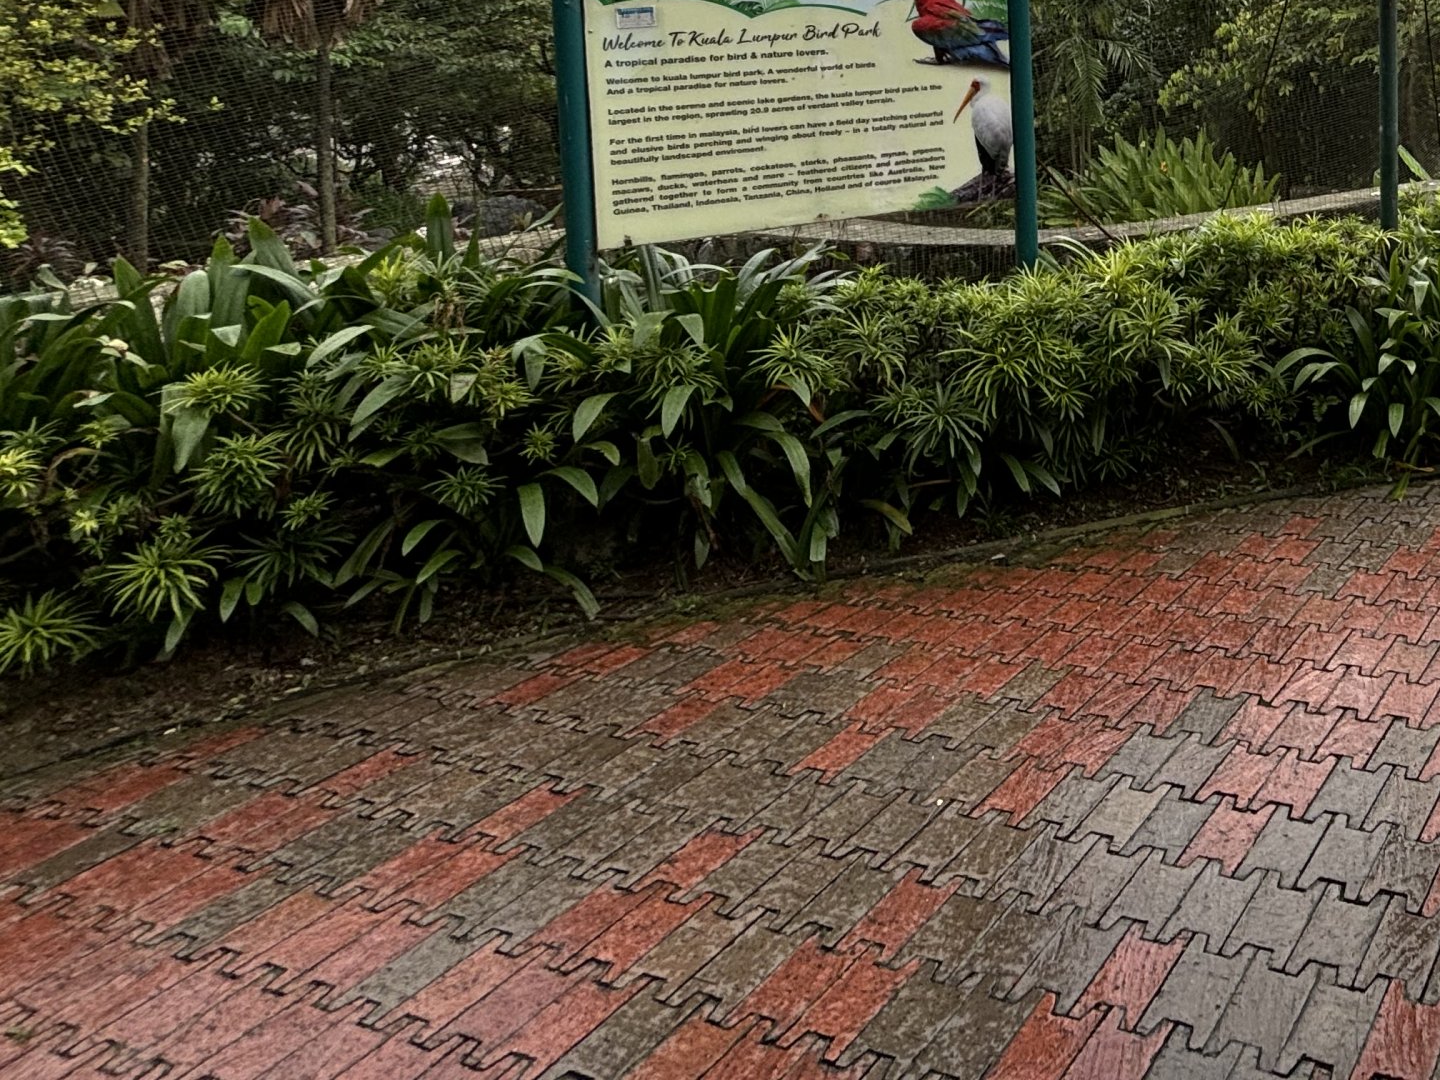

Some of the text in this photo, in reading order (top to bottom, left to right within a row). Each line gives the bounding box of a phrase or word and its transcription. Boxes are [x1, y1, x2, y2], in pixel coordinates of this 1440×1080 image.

[602, 21, 882, 52] Welcome To Kuala Lumpur Bird Park
[604, 59, 612, 67] A
[615, 57, 657, 67] tropical
[660, 54, 706, 66] paradise
[709, 53, 724, 61] for
[727, 51, 747, 60] bird
[760, 50, 793, 58] nature
[796, 48, 828, 56] lovers.
[662, 73, 687, 81] kuala
[775, 65, 817, 74] wonderful
[819, 63, 843, 71] world
[606, 87, 625, 95] And
[635, 84, 670, 93] tropical
[673, 82, 711, 91] paradise
[607, 106, 645, 115] Located
[726, 98, 754, 106] scenic
[757, 96, 775, 104] lake
[830, 90, 852, 98] kuala
[884, 86, 900, 94] bird
[901, 85, 918, 94] park
[608, 117, 640, 125] largest
[671, 112, 702, 120] region,
[807, 101, 838, 109] verdant
[609, 147, 627, 155] and
[631, 145, 663, 153] elusive
[667, 142, 690, 150] birds
[693, 139, 732, 149] perching
[735, 136, 752, 144] and
[755, 134, 788, 142] winging
[791, 131, 815, 139] about
[818, 128, 842, 136] freely
[871, 123, 895, 131] totally
[898, 120, 926, 129] natural
[929, 118, 943, 126] and
[645, 134, 663, 142] first
[699, 128, 740, 137] malaysia,
[871, 113, 907, 122] watching
[909, 109, 943, 119] colourful
[610, 155, 659, 165] beautifully
[661, 149, 713, 160] landscaped
